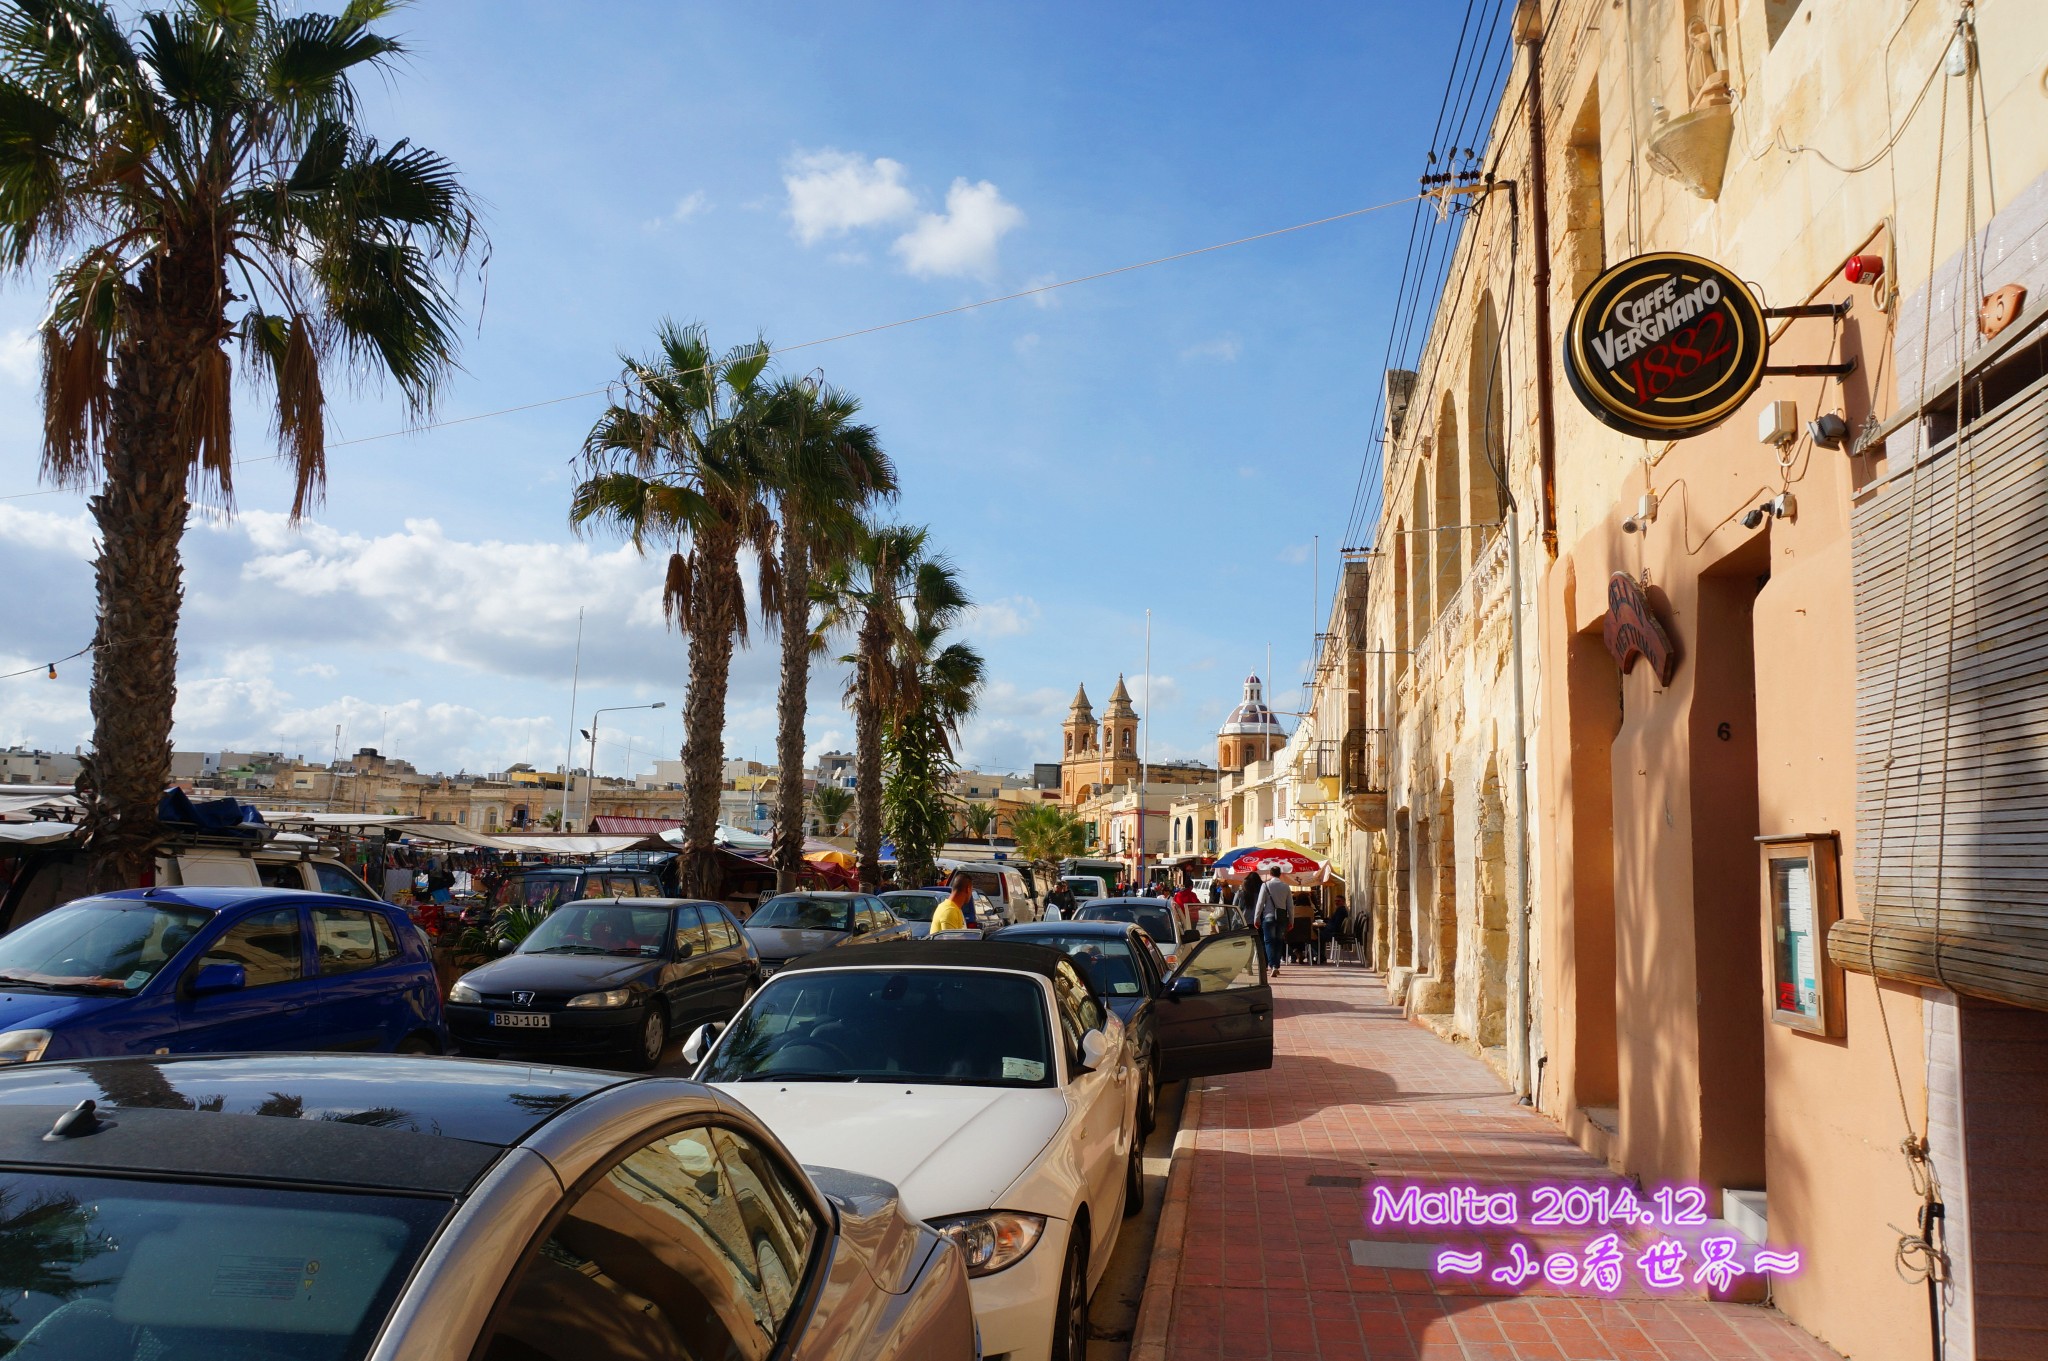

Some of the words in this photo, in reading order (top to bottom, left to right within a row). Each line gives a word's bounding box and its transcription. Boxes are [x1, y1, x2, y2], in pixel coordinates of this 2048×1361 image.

[1591, 279, 1720, 369] VERGNANO
[1627, 312, 1732, 406] 1882
[1717, 722, 1731, 741] 6
